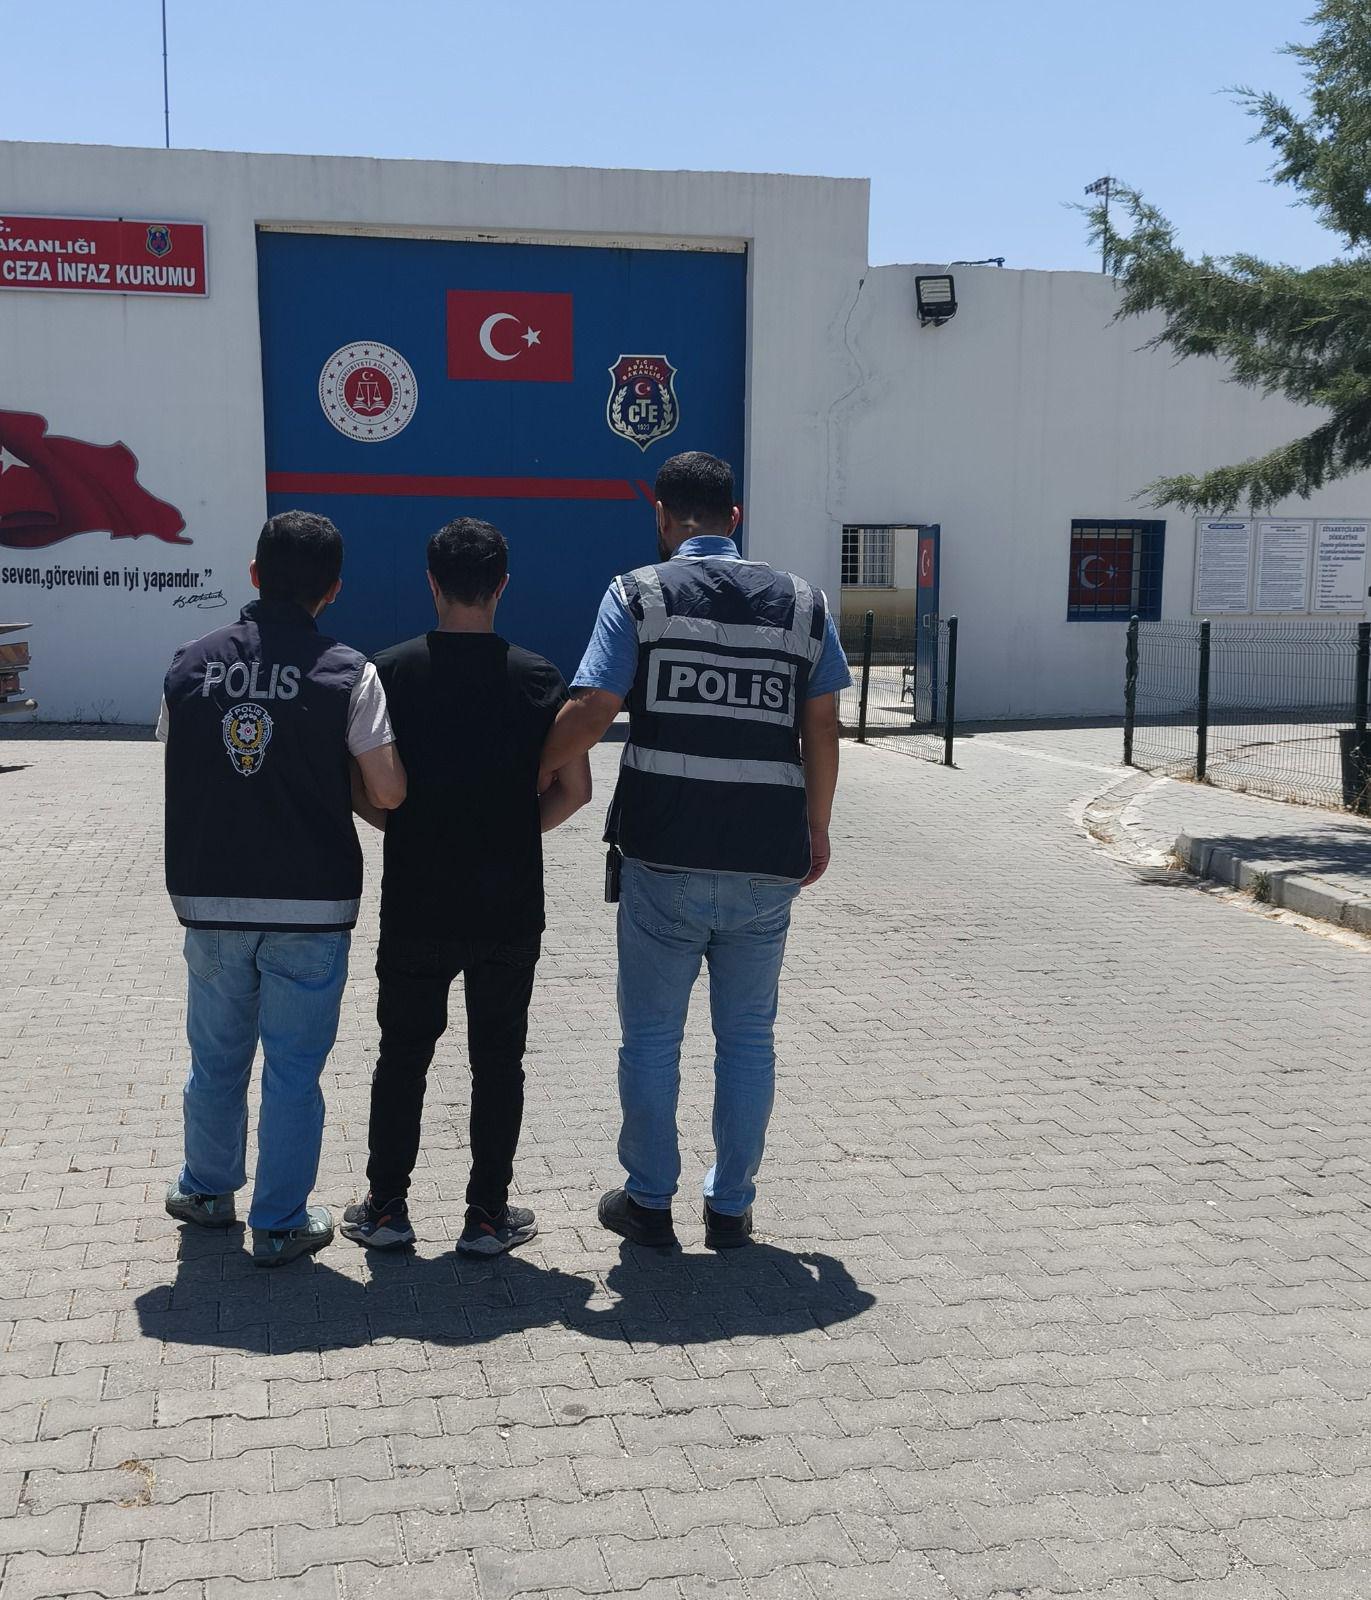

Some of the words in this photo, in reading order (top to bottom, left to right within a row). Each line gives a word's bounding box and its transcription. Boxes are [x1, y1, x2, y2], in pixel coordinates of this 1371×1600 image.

[3, 260, 52, 281] CEZA
[57, 258, 111, 284] İNFAZ
[116, 264, 196, 287] KURUMU
[628, 399, 658, 423] CTE
[103, 570, 119, 586] en
[124, 567, 139, 591] iyi
